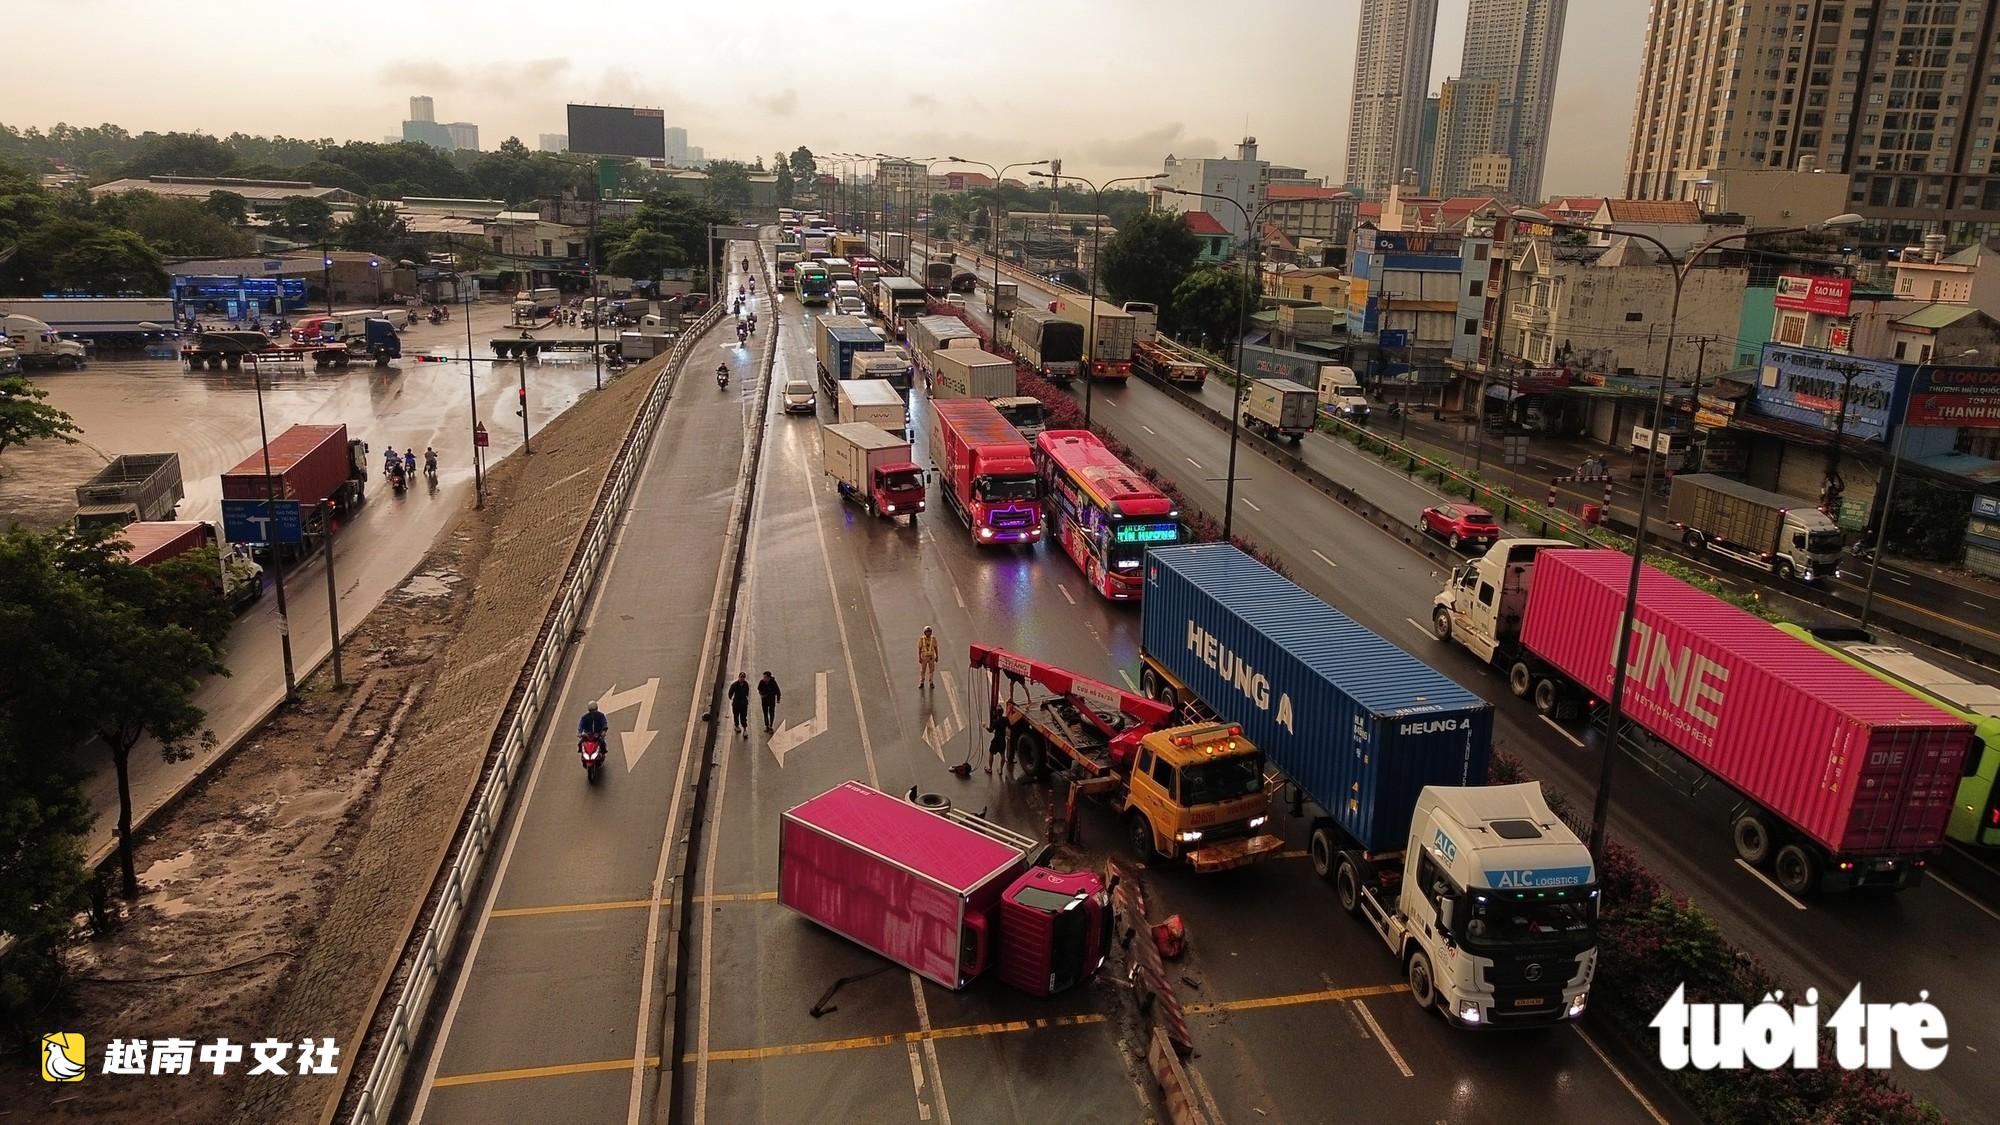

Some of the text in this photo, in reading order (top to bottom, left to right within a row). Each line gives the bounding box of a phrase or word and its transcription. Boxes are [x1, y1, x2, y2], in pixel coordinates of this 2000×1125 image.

[1406, 238, 1427, 252] VMI
[1814, 286, 1829, 296] SAO
[1829, 287, 1843, 298] MAI
[1938, 406, 1984, 418] THANH
[1187, 620, 1271, 711] HEUNG
[1275, 693, 1294, 736] A
[1609, 611, 1730, 730] ONE
[1400, 718, 1471, 736] HEUNG A
[1635, 692, 1674, 723] NETWORK
[1675, 719, 1714, 748] EXPRESS
[1870, 751, 1905, 766] ONE
[1499, 870, 1579, 888] ALC LOGISTICS
